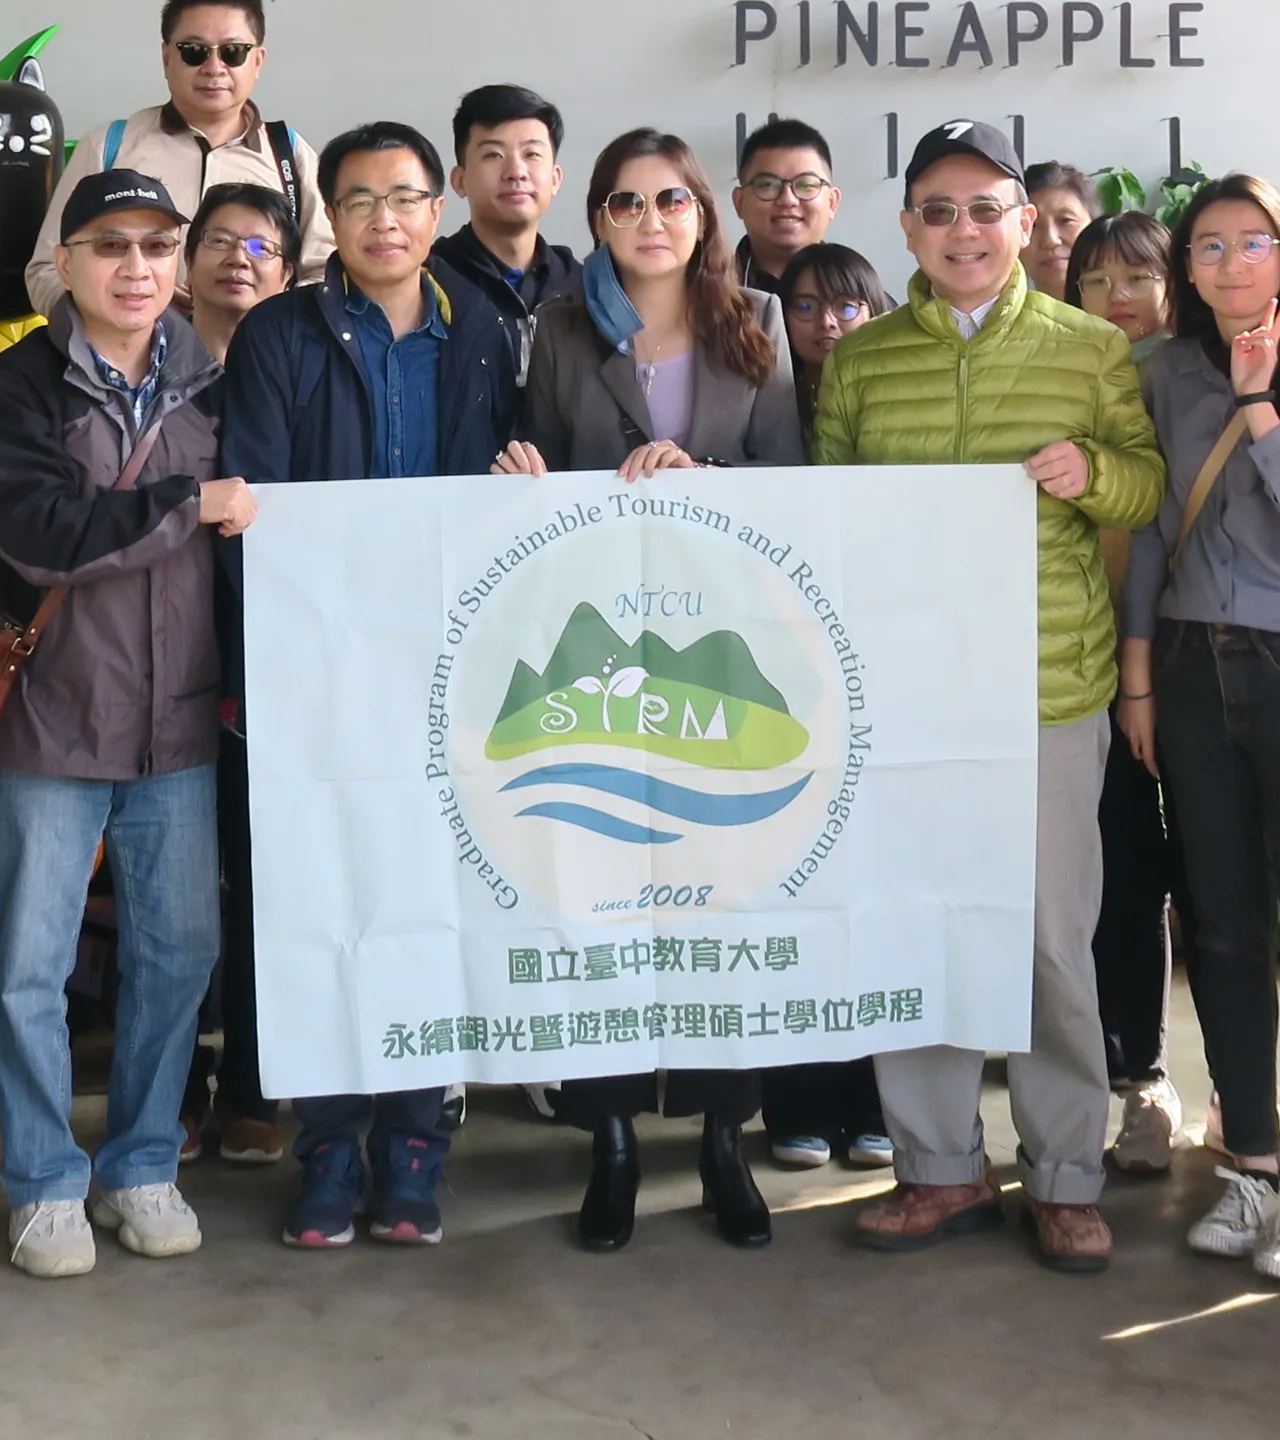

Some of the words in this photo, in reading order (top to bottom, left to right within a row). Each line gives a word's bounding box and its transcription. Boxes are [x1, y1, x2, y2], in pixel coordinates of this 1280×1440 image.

[734, 0, 1205, 68] PINEAPPLE
[281, 159, 293, 182] EOS
[609, 493, 732, 534] Tourism
[458, 503, 604, 614] Sustainable
[737, 521, 792, 567] and
[446, 609, 470, 645] of
[615, 584, 704, 619] NTCU
[787, 559, 867, 712] Recreation
[425, 653, 455, 782] Program
[778, 723, 873, 899] Management
[438, 786, 519, 910] Graduate
[591, 899, 632, 913] since
[637, 883, 714, 909] 2008
[507, 935, 799, 984] 國立臺中教育大學
[382, 987, 924, 1060] 永續觀光暨遊憩管理碩士學位學程
